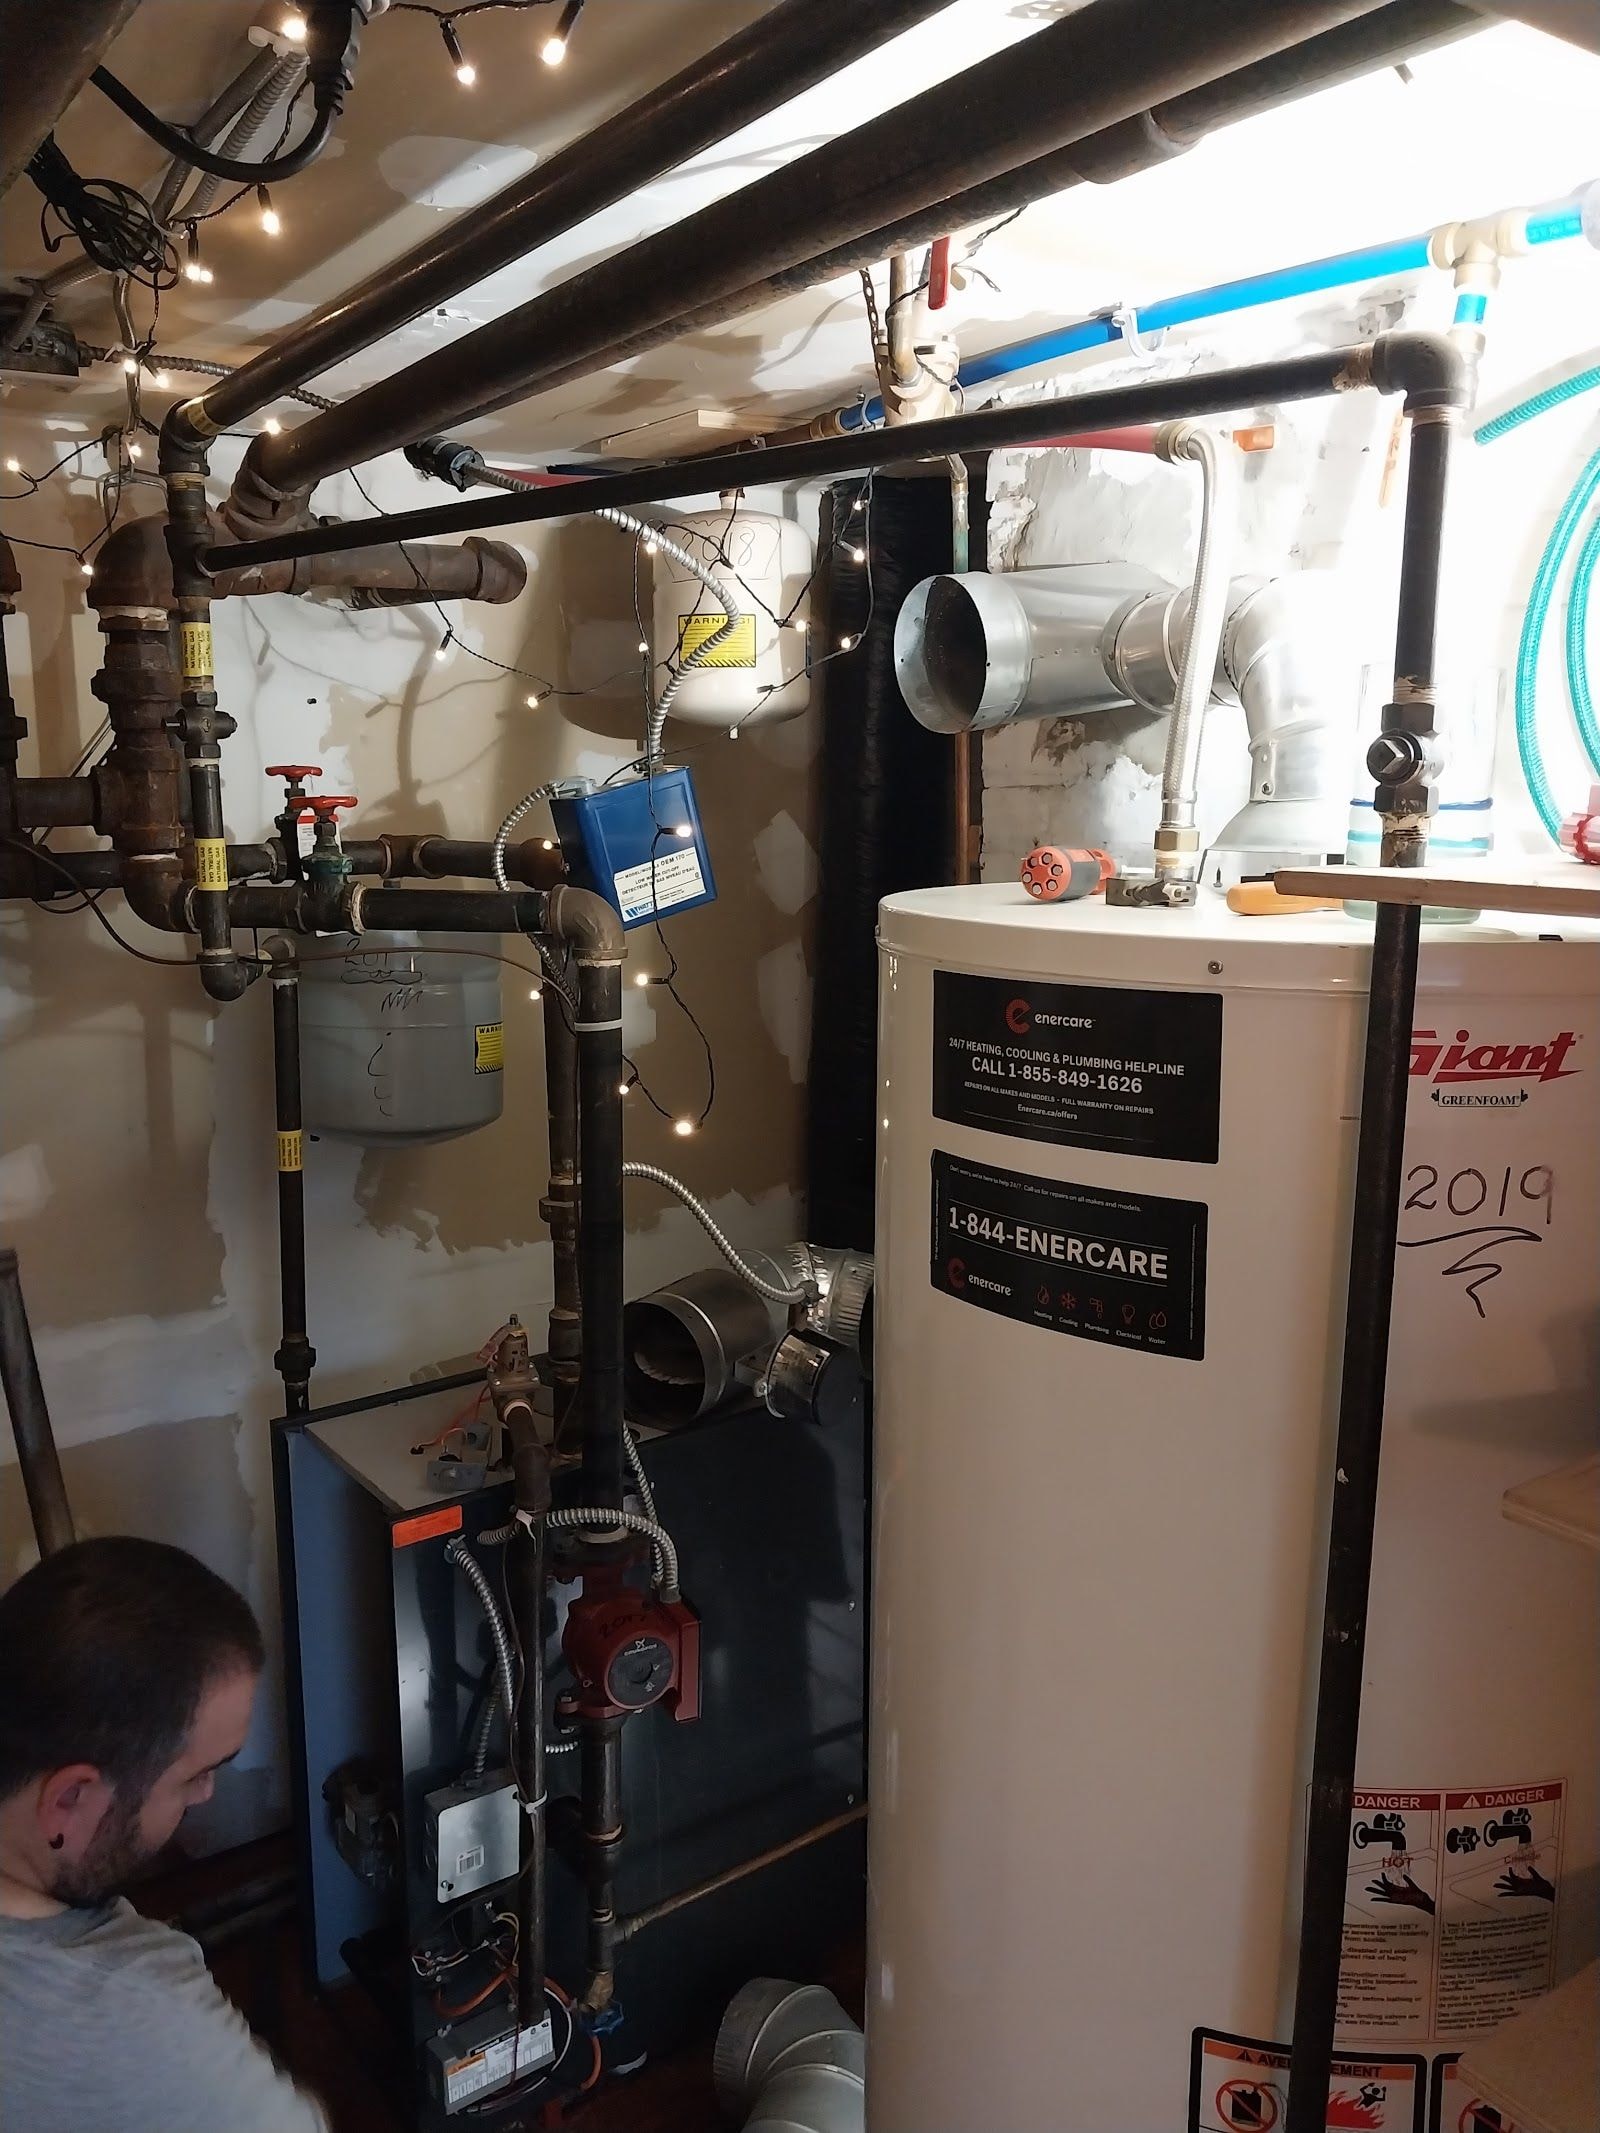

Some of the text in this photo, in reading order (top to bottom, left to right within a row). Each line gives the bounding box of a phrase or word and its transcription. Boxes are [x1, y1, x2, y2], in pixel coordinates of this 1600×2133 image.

[684, 617, 750, 625] WARNIG!
[1034, 1012, 1093, 1028] enercare
[949, 1037, 1184, 1076] 24/7 HEATING, COOLING & PLUMBING HELPLINE
[972, 1057, 1142, 1093] CALL 1-855-849-1626
[1000, 1086, 1018, 1097] MAKES
[1019, 1090, 1030, 1099] AND
[1031, 1092, 1055, 1103] MODELS
[1062, 1097, 1076, 1106] FULL
[1076, 1099, 1113, 1110] WARRANTY
[1114, 1103, 1124, 1112] ON
[1125, 1104, 1154, 1114] REPAIRS
[1441, 1095, 1517, 1106] GREENFOAM
[1017, 1104, 1078, 1120] Enercare.ca/offers
[1404, 1164, 1556, 1225] 2019
[1085, 1198, 1104, 1207] makes
[1105, 1200, 1116, 1209] and
[949, 1206, 1168, 1280] 1-844-ENERCARE
[968, 1274, 1012, 1296] enercare
[1148, 1336, 1166, 1345] Water
[1354, 1795, 1420, 1809] DANGER
[1485, 1789, 1544, 1806] DANGER
[1382, 1857, 1413, 1868] HOT
